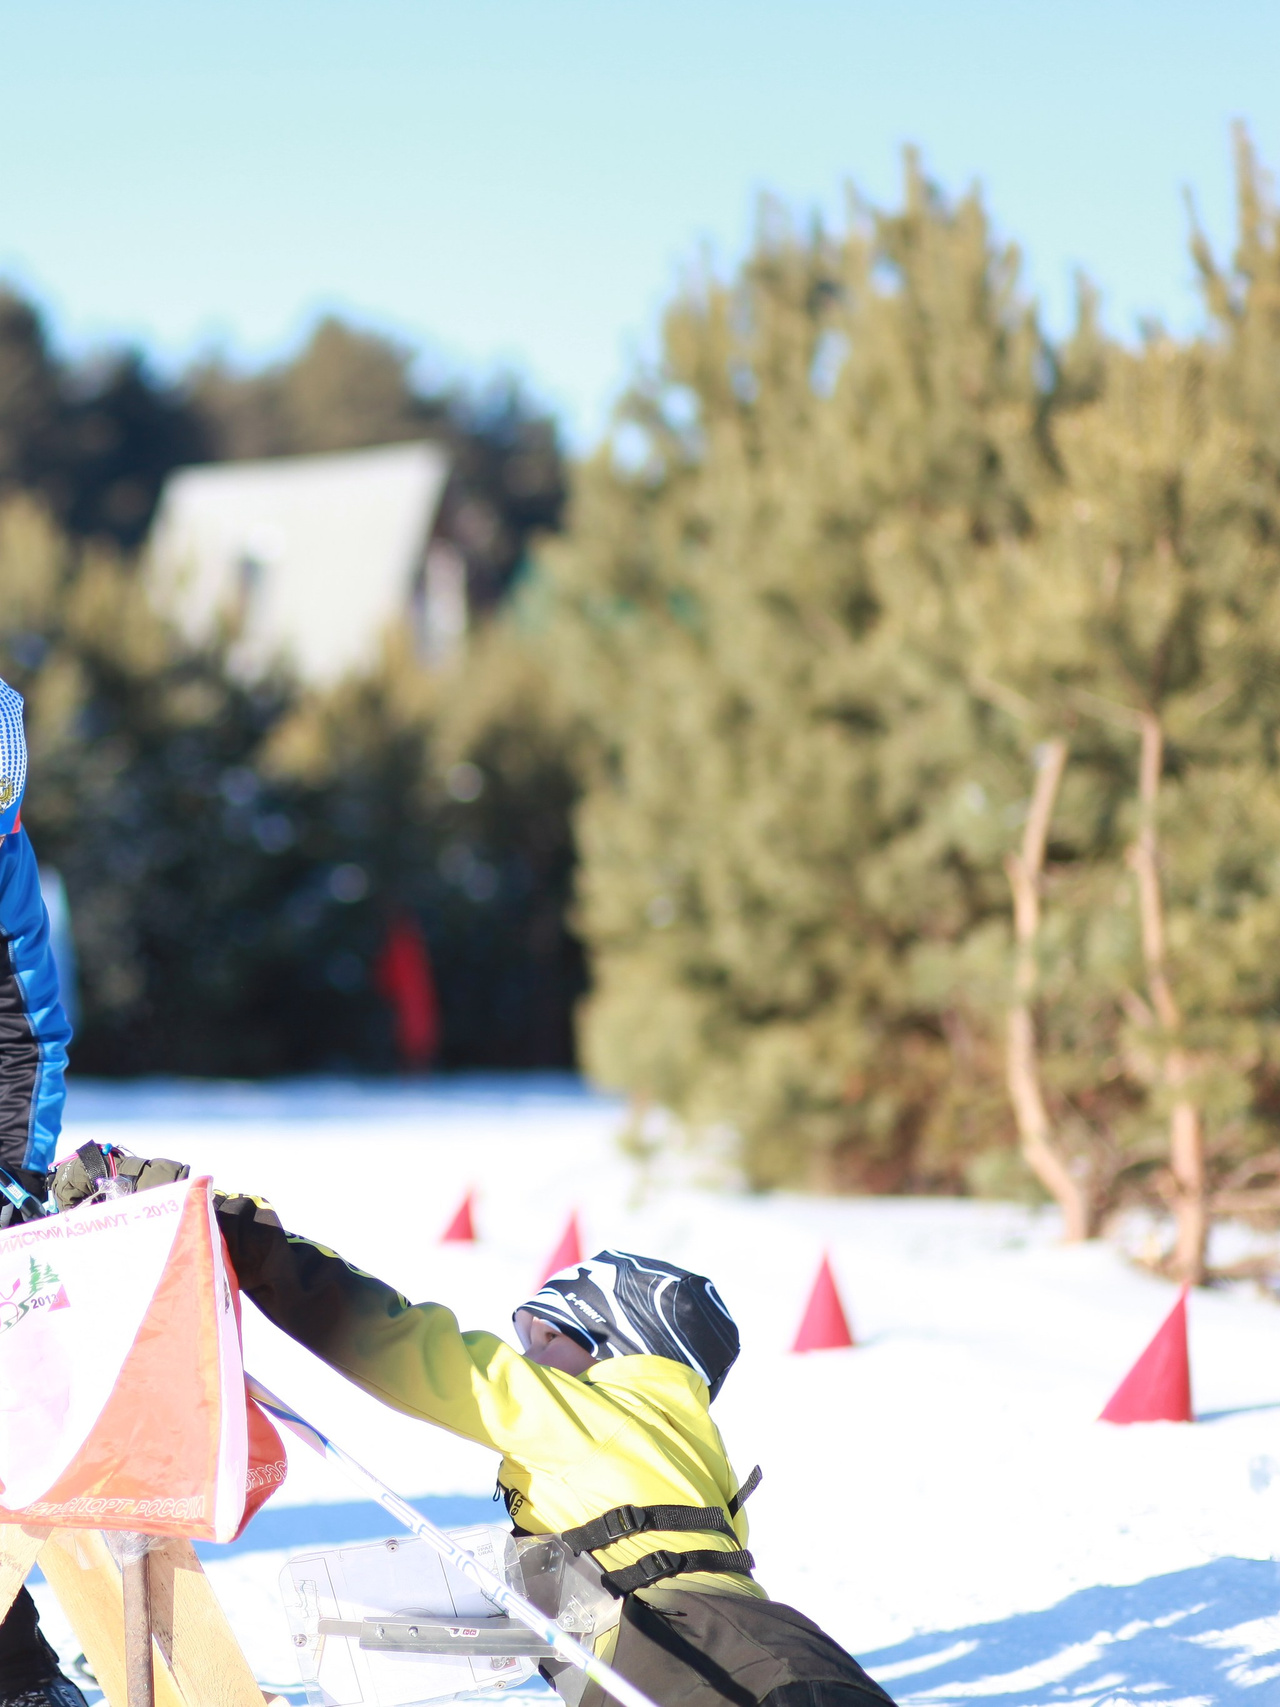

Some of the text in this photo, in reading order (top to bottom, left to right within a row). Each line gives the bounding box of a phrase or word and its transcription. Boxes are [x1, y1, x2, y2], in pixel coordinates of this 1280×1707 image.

[66, 1213, 130, 1239] АЗИМУТ
[143, 1200, 179, 1220] 2013
[31, 1294, 59, 1310] 2013
